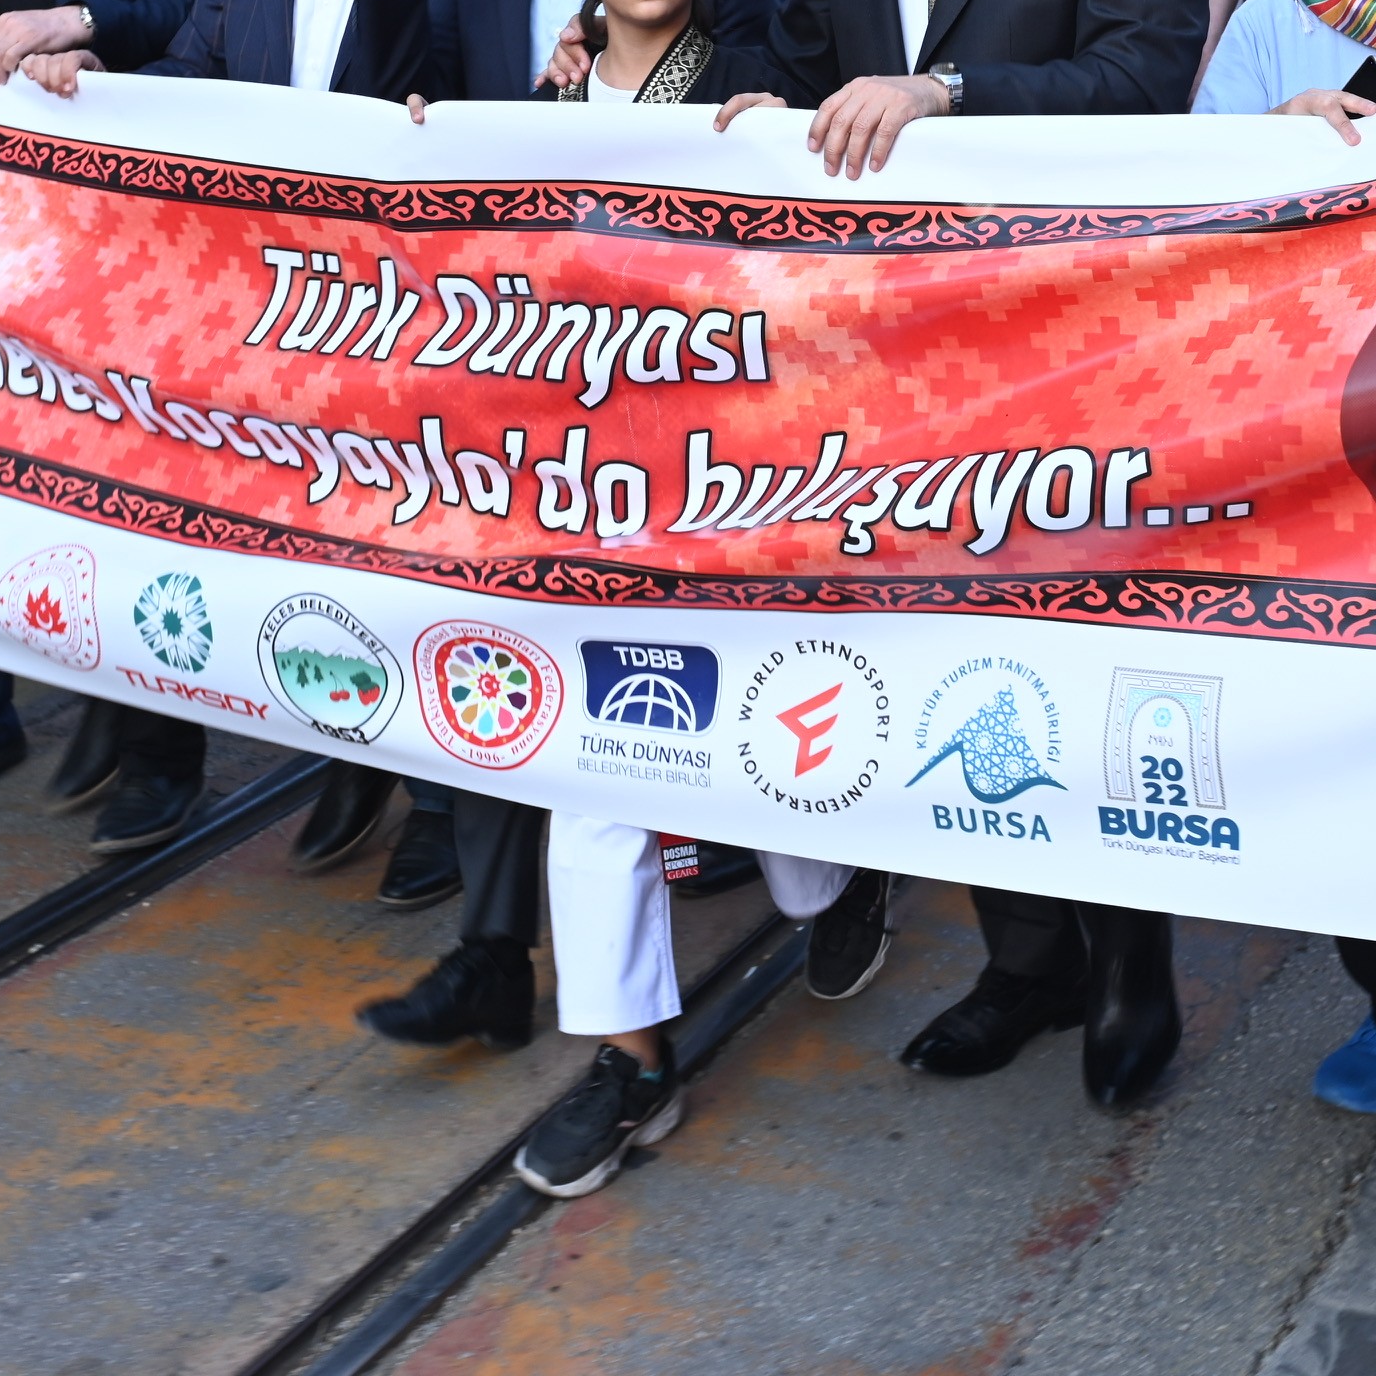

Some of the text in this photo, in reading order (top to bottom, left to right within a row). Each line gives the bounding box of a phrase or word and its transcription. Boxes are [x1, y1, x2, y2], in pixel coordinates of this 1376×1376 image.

[245, 246, 768, 409] Türk Dünyası
[667, 429, 1253, 555] buluşuyor...
[262, 599, 386, 653] KELES BELEDİYESİ
[612, 645, 685, 671] TDBB
[450, 624, 485, 637] Spor
[510, 664, 558, 756] Federasyonu
[914, 656, 1063, 764] KÜLTÜR TURİZM TANITMA BİRLİĞİ
[737, 639, 890, 814] WORLD ETHNOSPORT CONFEDERATION
[580, 732, 712, 770] TÜRK DÜNYASI
[1139, 755, 1184, 782] 20
[577, 757, 712, 789] BELEDİYELER BİRLİĞİ
[1142, 781, 1189, 807] 22
[931, 803, 1052, 843] BURSA
[1097, 805, 1240, 851] BURSA
[1101, 837, 1124, 850] Türk
[1125, 840, 1164, 855] Dünyası
[667, 866, 699, 880] GEARS
